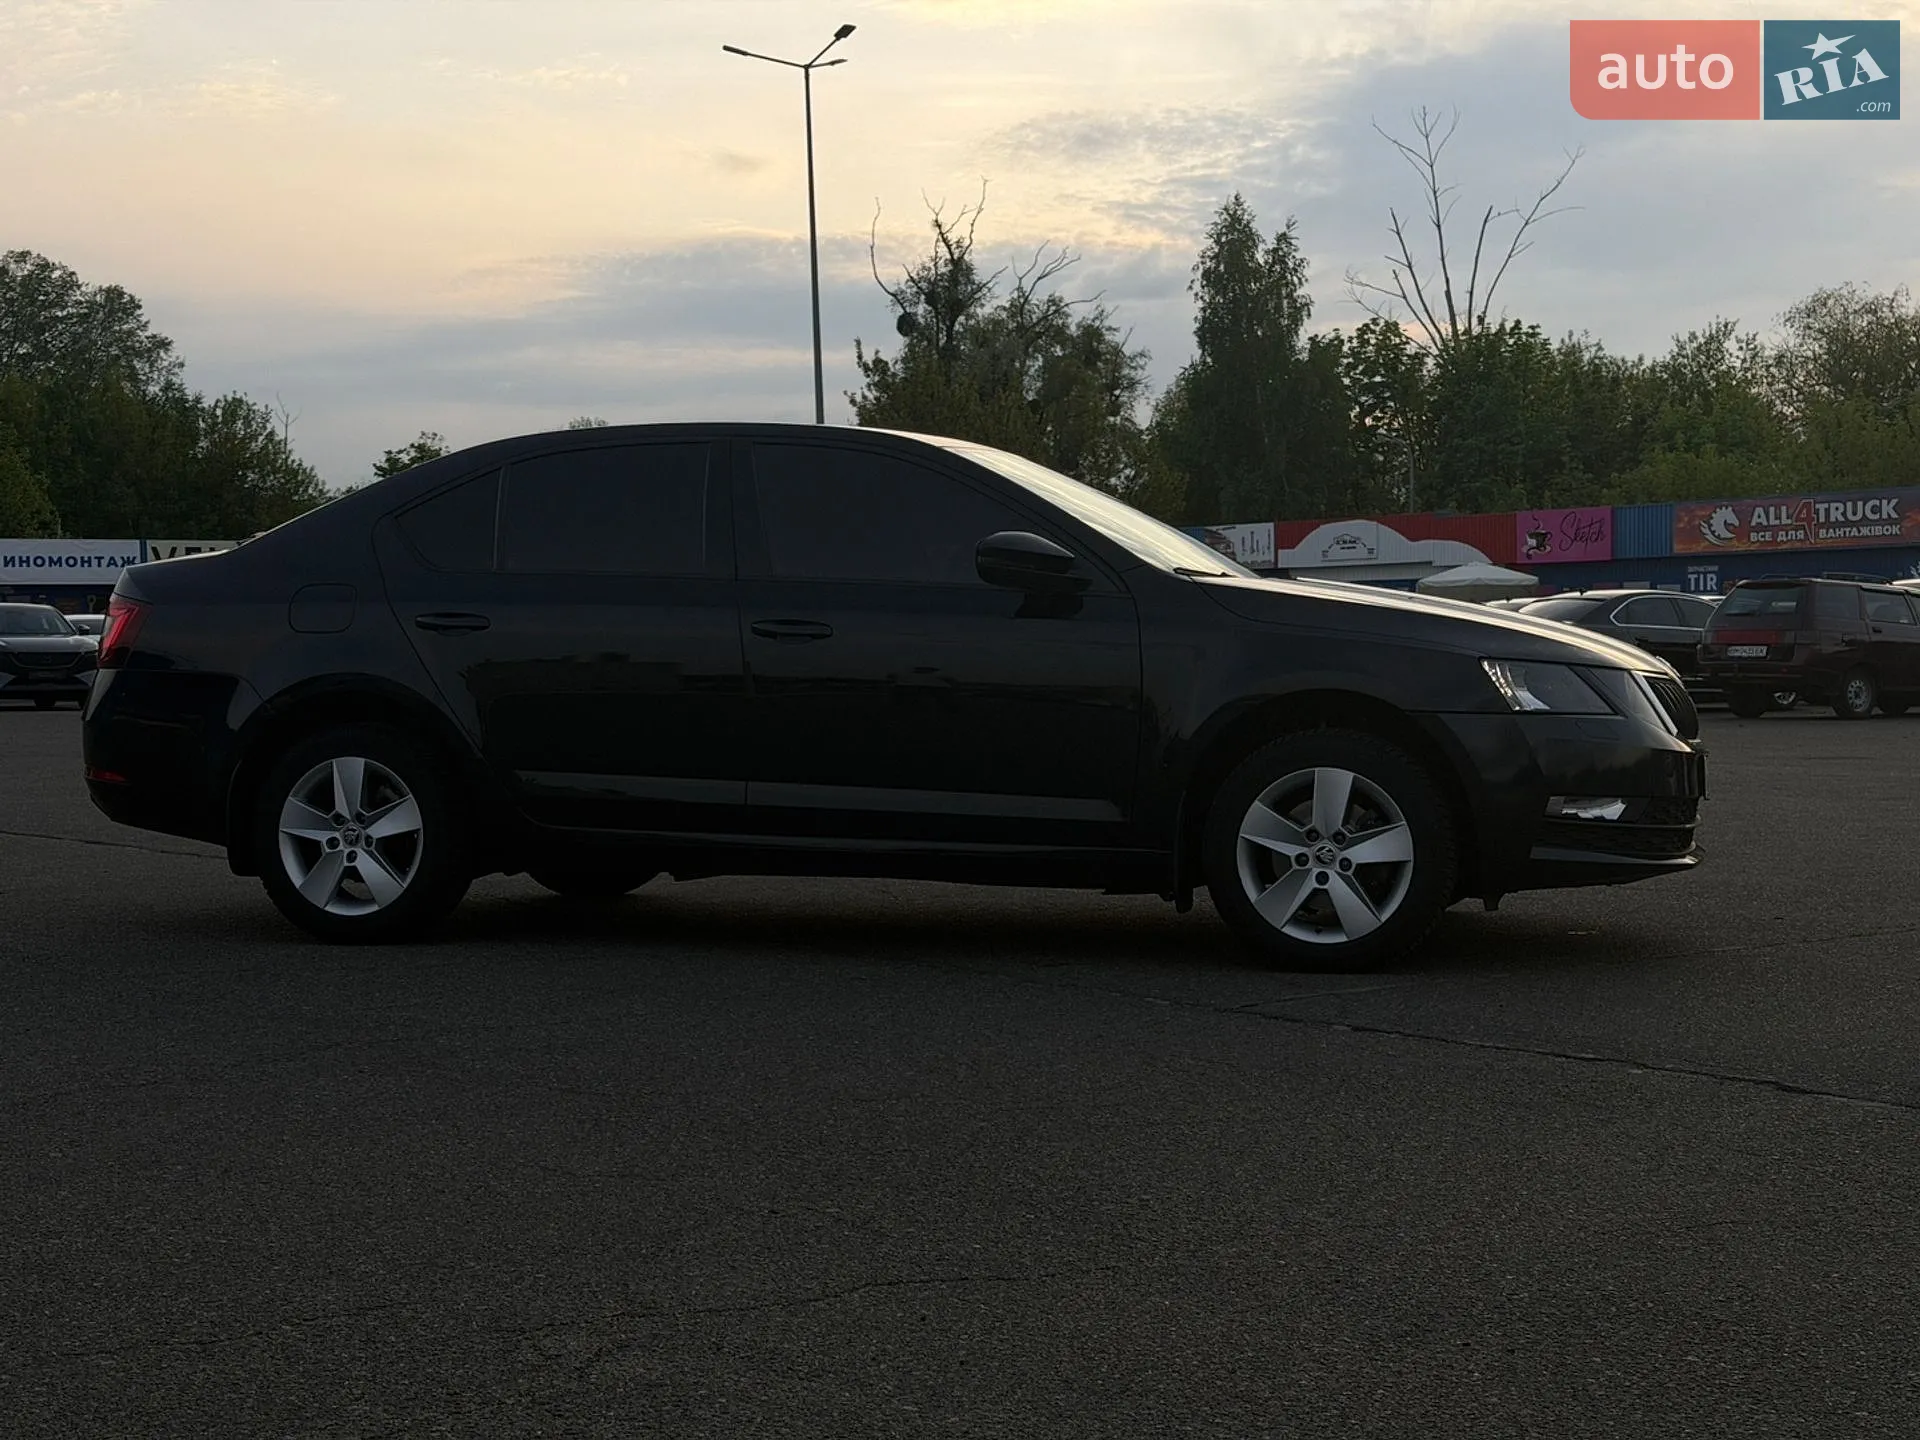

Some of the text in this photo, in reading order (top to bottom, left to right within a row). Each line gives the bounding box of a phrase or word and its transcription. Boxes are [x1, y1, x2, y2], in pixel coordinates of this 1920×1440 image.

[1559, 511, 1606, 555] Sketch
[1750, 525, 1900, 542] ВСЕ ДЛЯ ВАНТАЖІВОК
[1687, 573, 1718, 592] TIR
